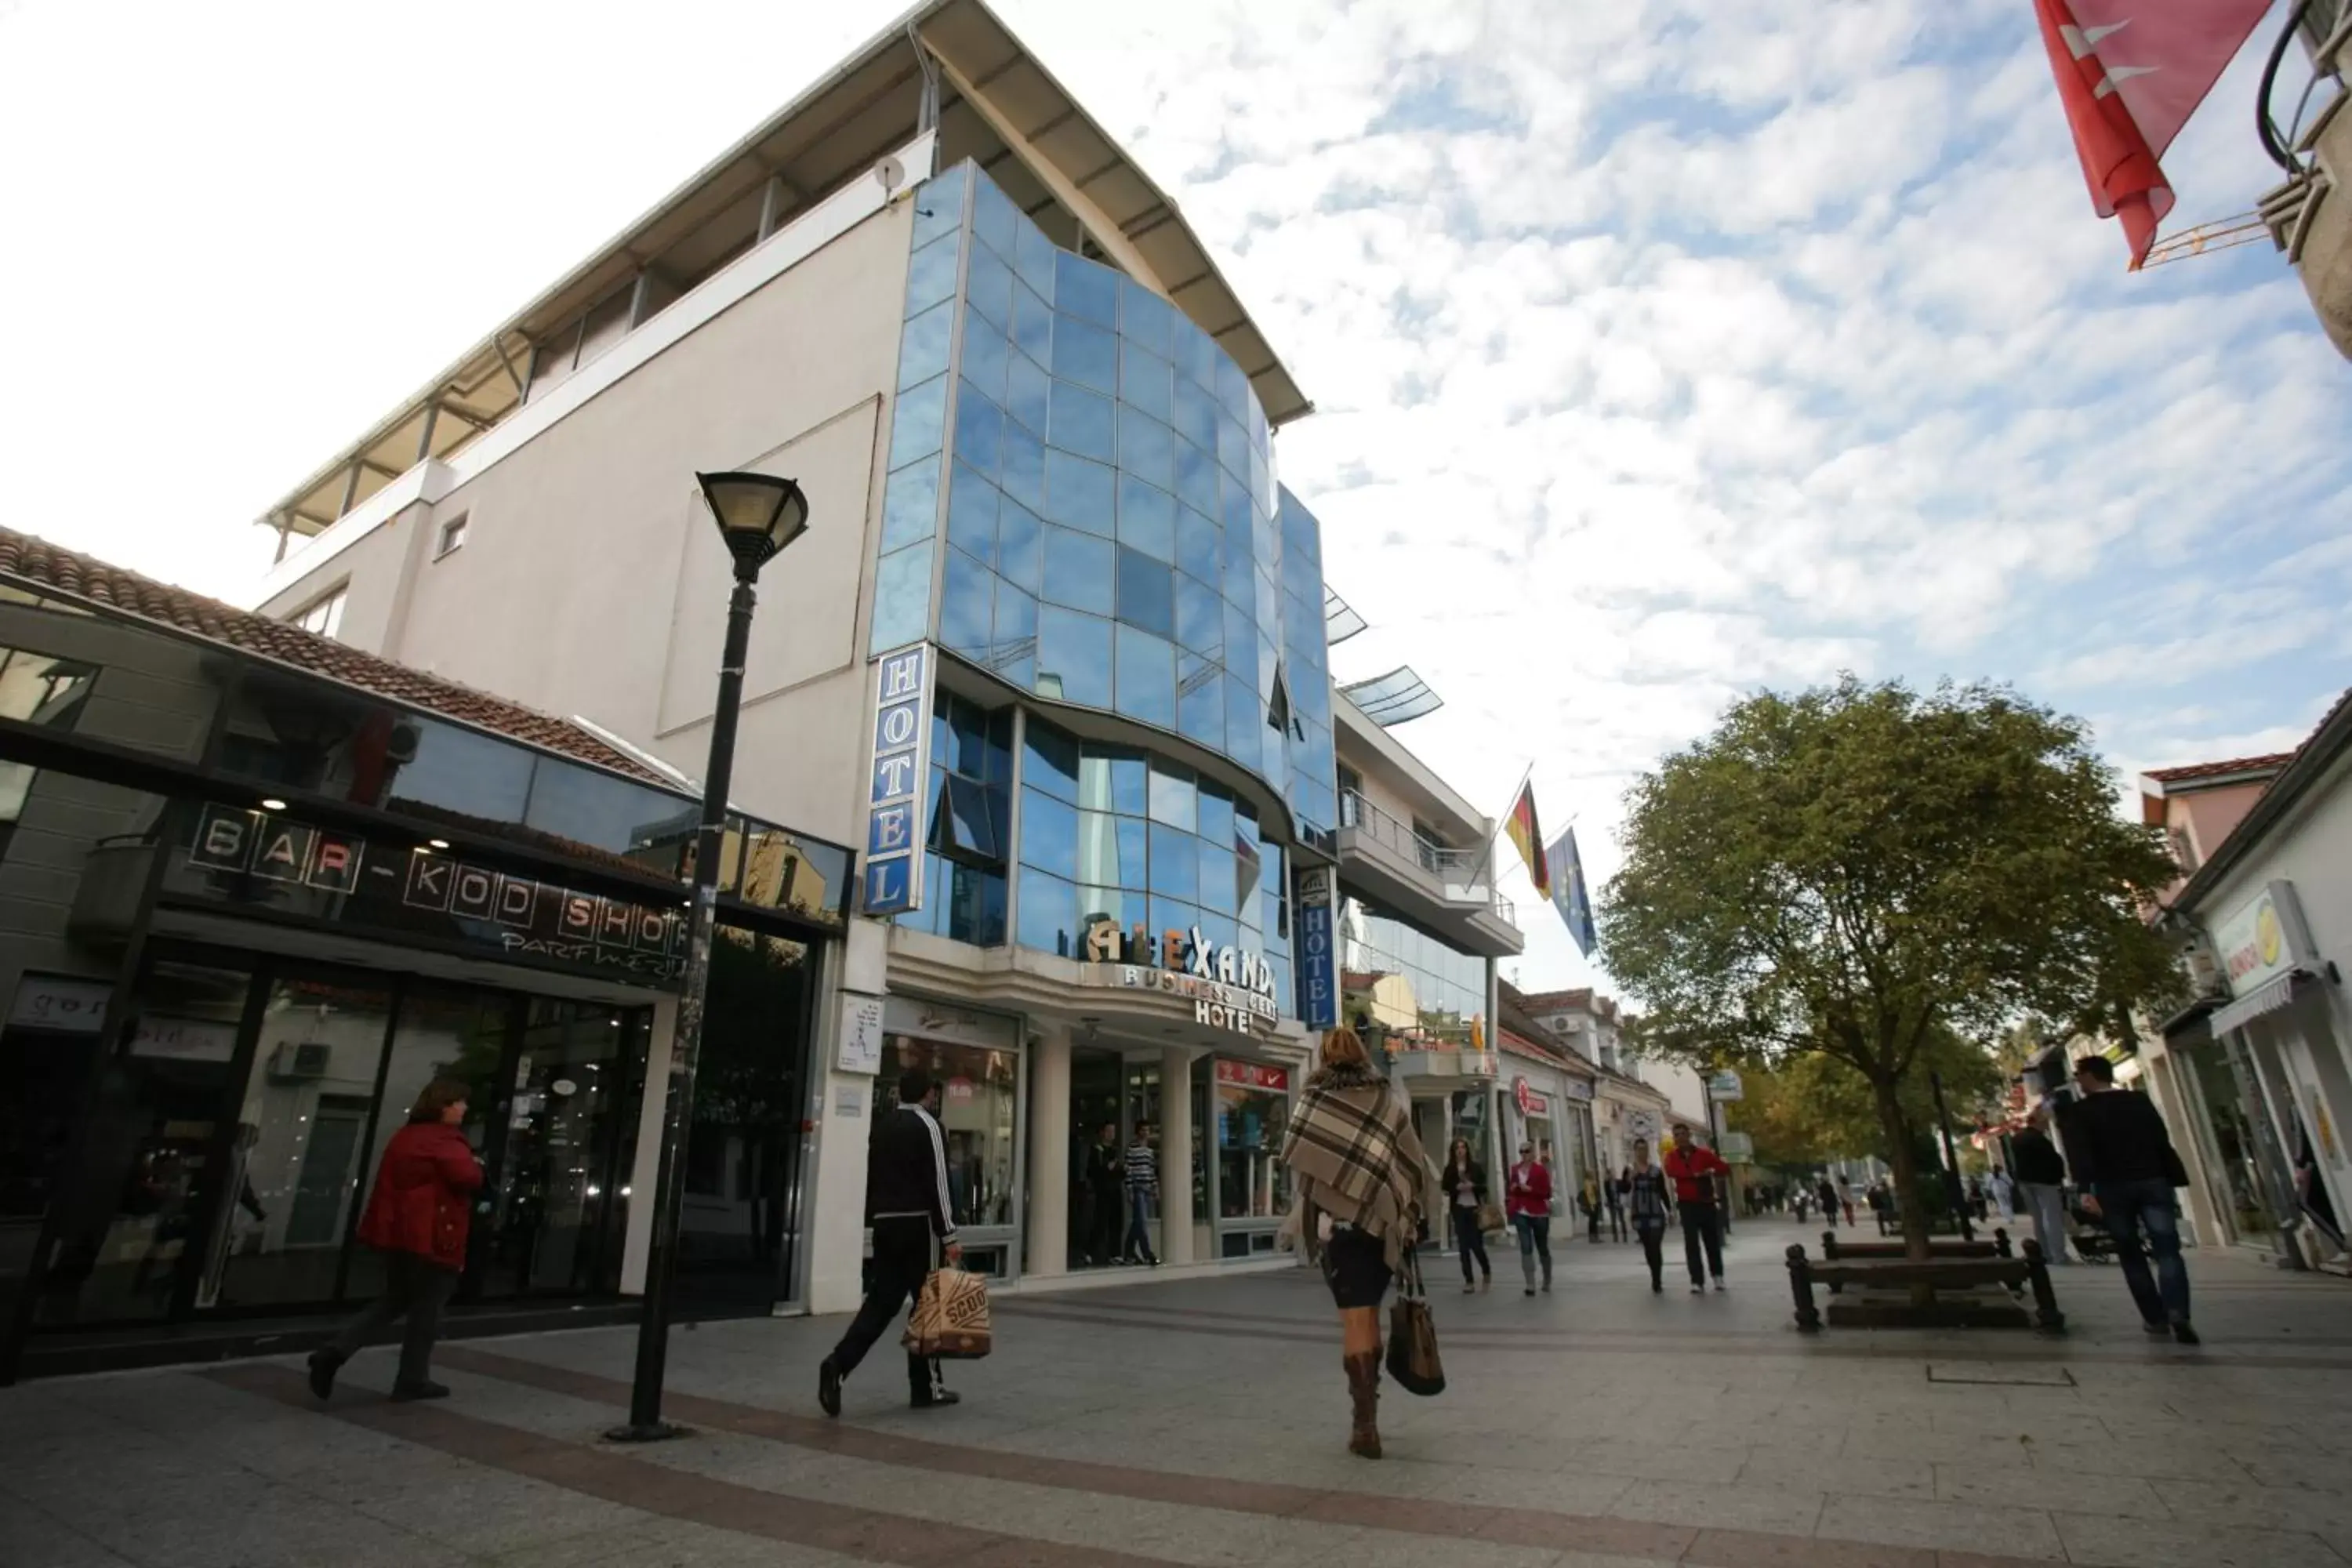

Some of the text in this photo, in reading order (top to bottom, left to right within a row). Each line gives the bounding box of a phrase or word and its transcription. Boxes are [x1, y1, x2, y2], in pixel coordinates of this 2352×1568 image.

[870, 652, 919, 906] HOTEL
[1124, 967, 1278, 1021] BUSINESS CENT
[1306, 909, 1328, 1025] HOTEL
